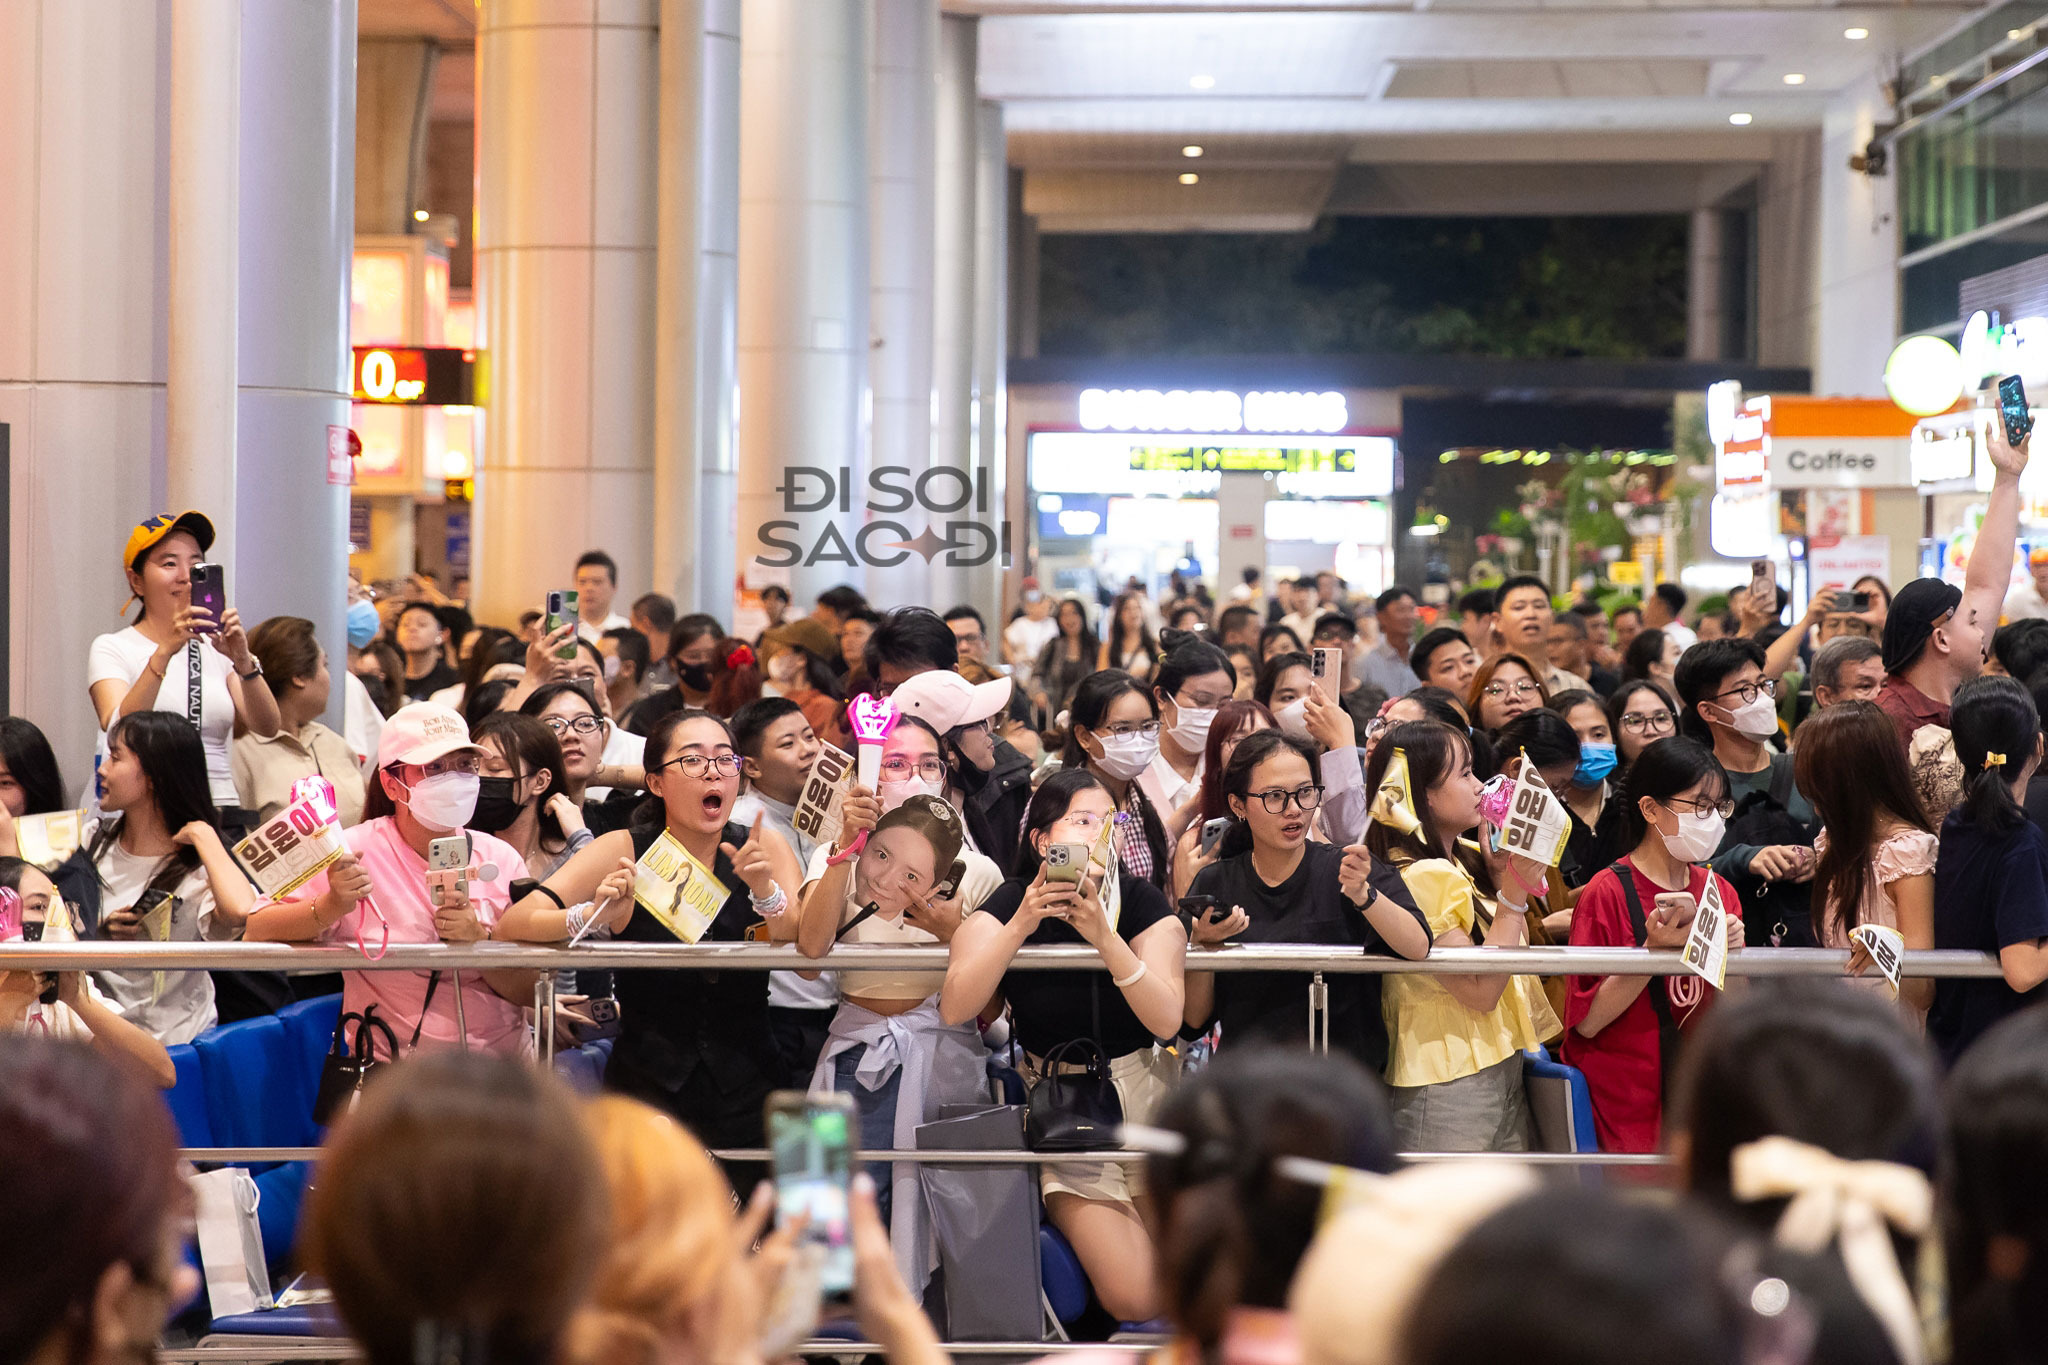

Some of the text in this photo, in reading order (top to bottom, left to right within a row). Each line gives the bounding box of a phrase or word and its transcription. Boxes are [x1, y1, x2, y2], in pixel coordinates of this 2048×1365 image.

[1787, 449, 1875, 471] Coffee
[189, 639, 201, 731] UTICA NAUT
[797, 748, 849, 838] 임윤아
[643, 844, 678, 882] LIM
